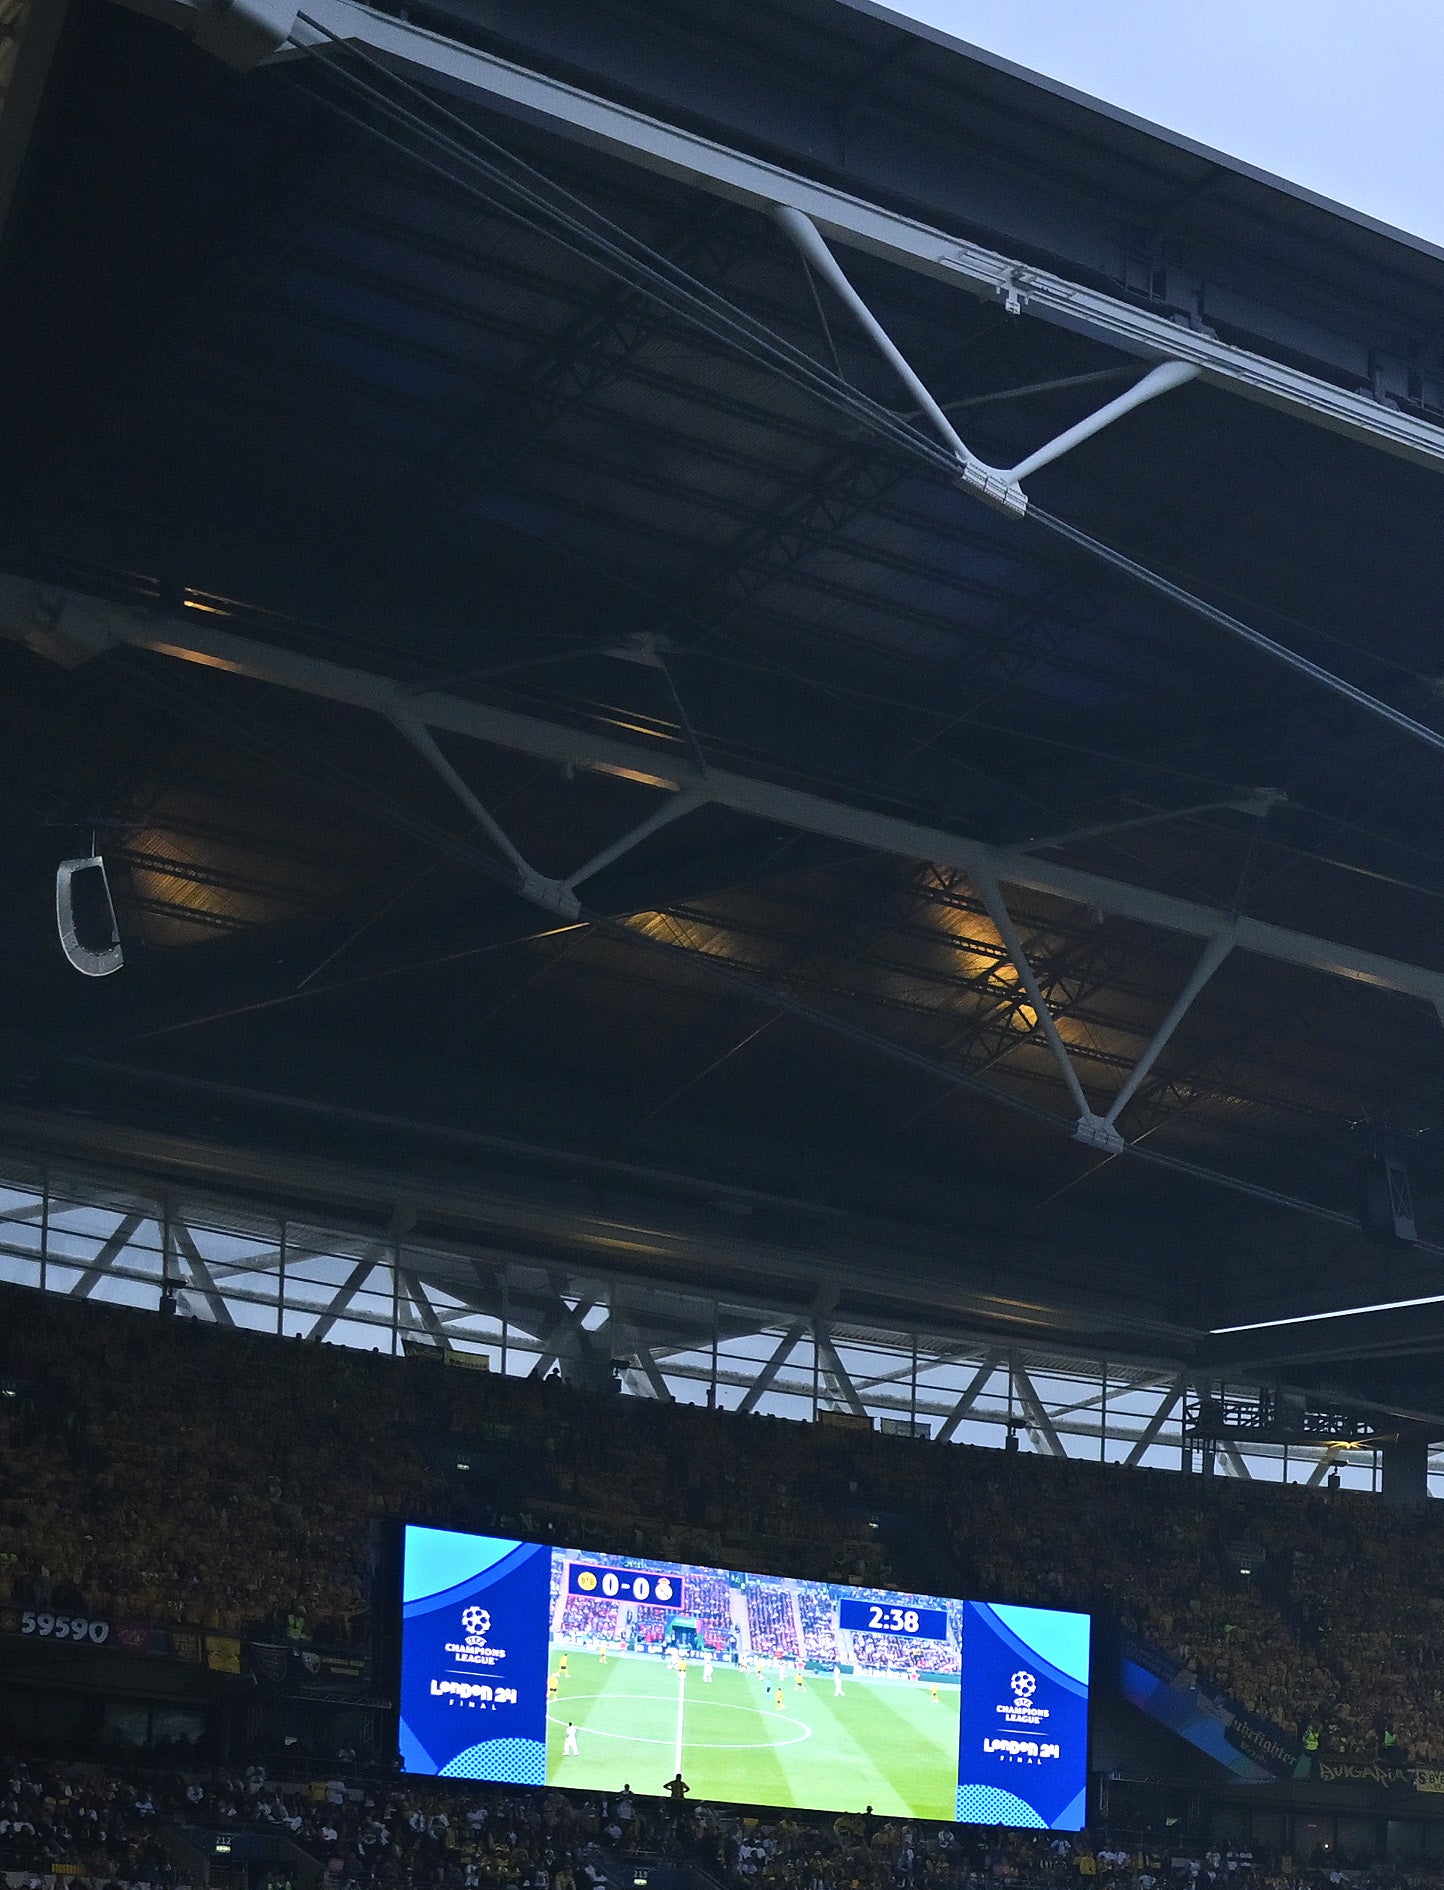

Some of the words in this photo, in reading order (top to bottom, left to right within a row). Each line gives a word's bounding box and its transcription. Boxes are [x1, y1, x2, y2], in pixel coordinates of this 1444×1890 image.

[869, 1607, 920, 1633] 2:38
[21, 1611, 110, 1644] 59590
[445, 1643, 506, 1659] CHAMPIONS
[455, 1654, 496, 1666] LEAGUE
[430, 1679, 493, 1702] London
[494, 1685, 517, 1704] 24
[449, 1699, 497, 1711] FINAL
[996, 1705, 1049, 1718] CHAMPIONS
[1005, 1713, 1043, 1725] LEAGUE
[983, 1738, 1038, 1756] London
[1039, 1744, 1060, 1758] 24
[1000, 1755, 1042, 1765] FINAL
[216, 1836, 231, 1845] 212
